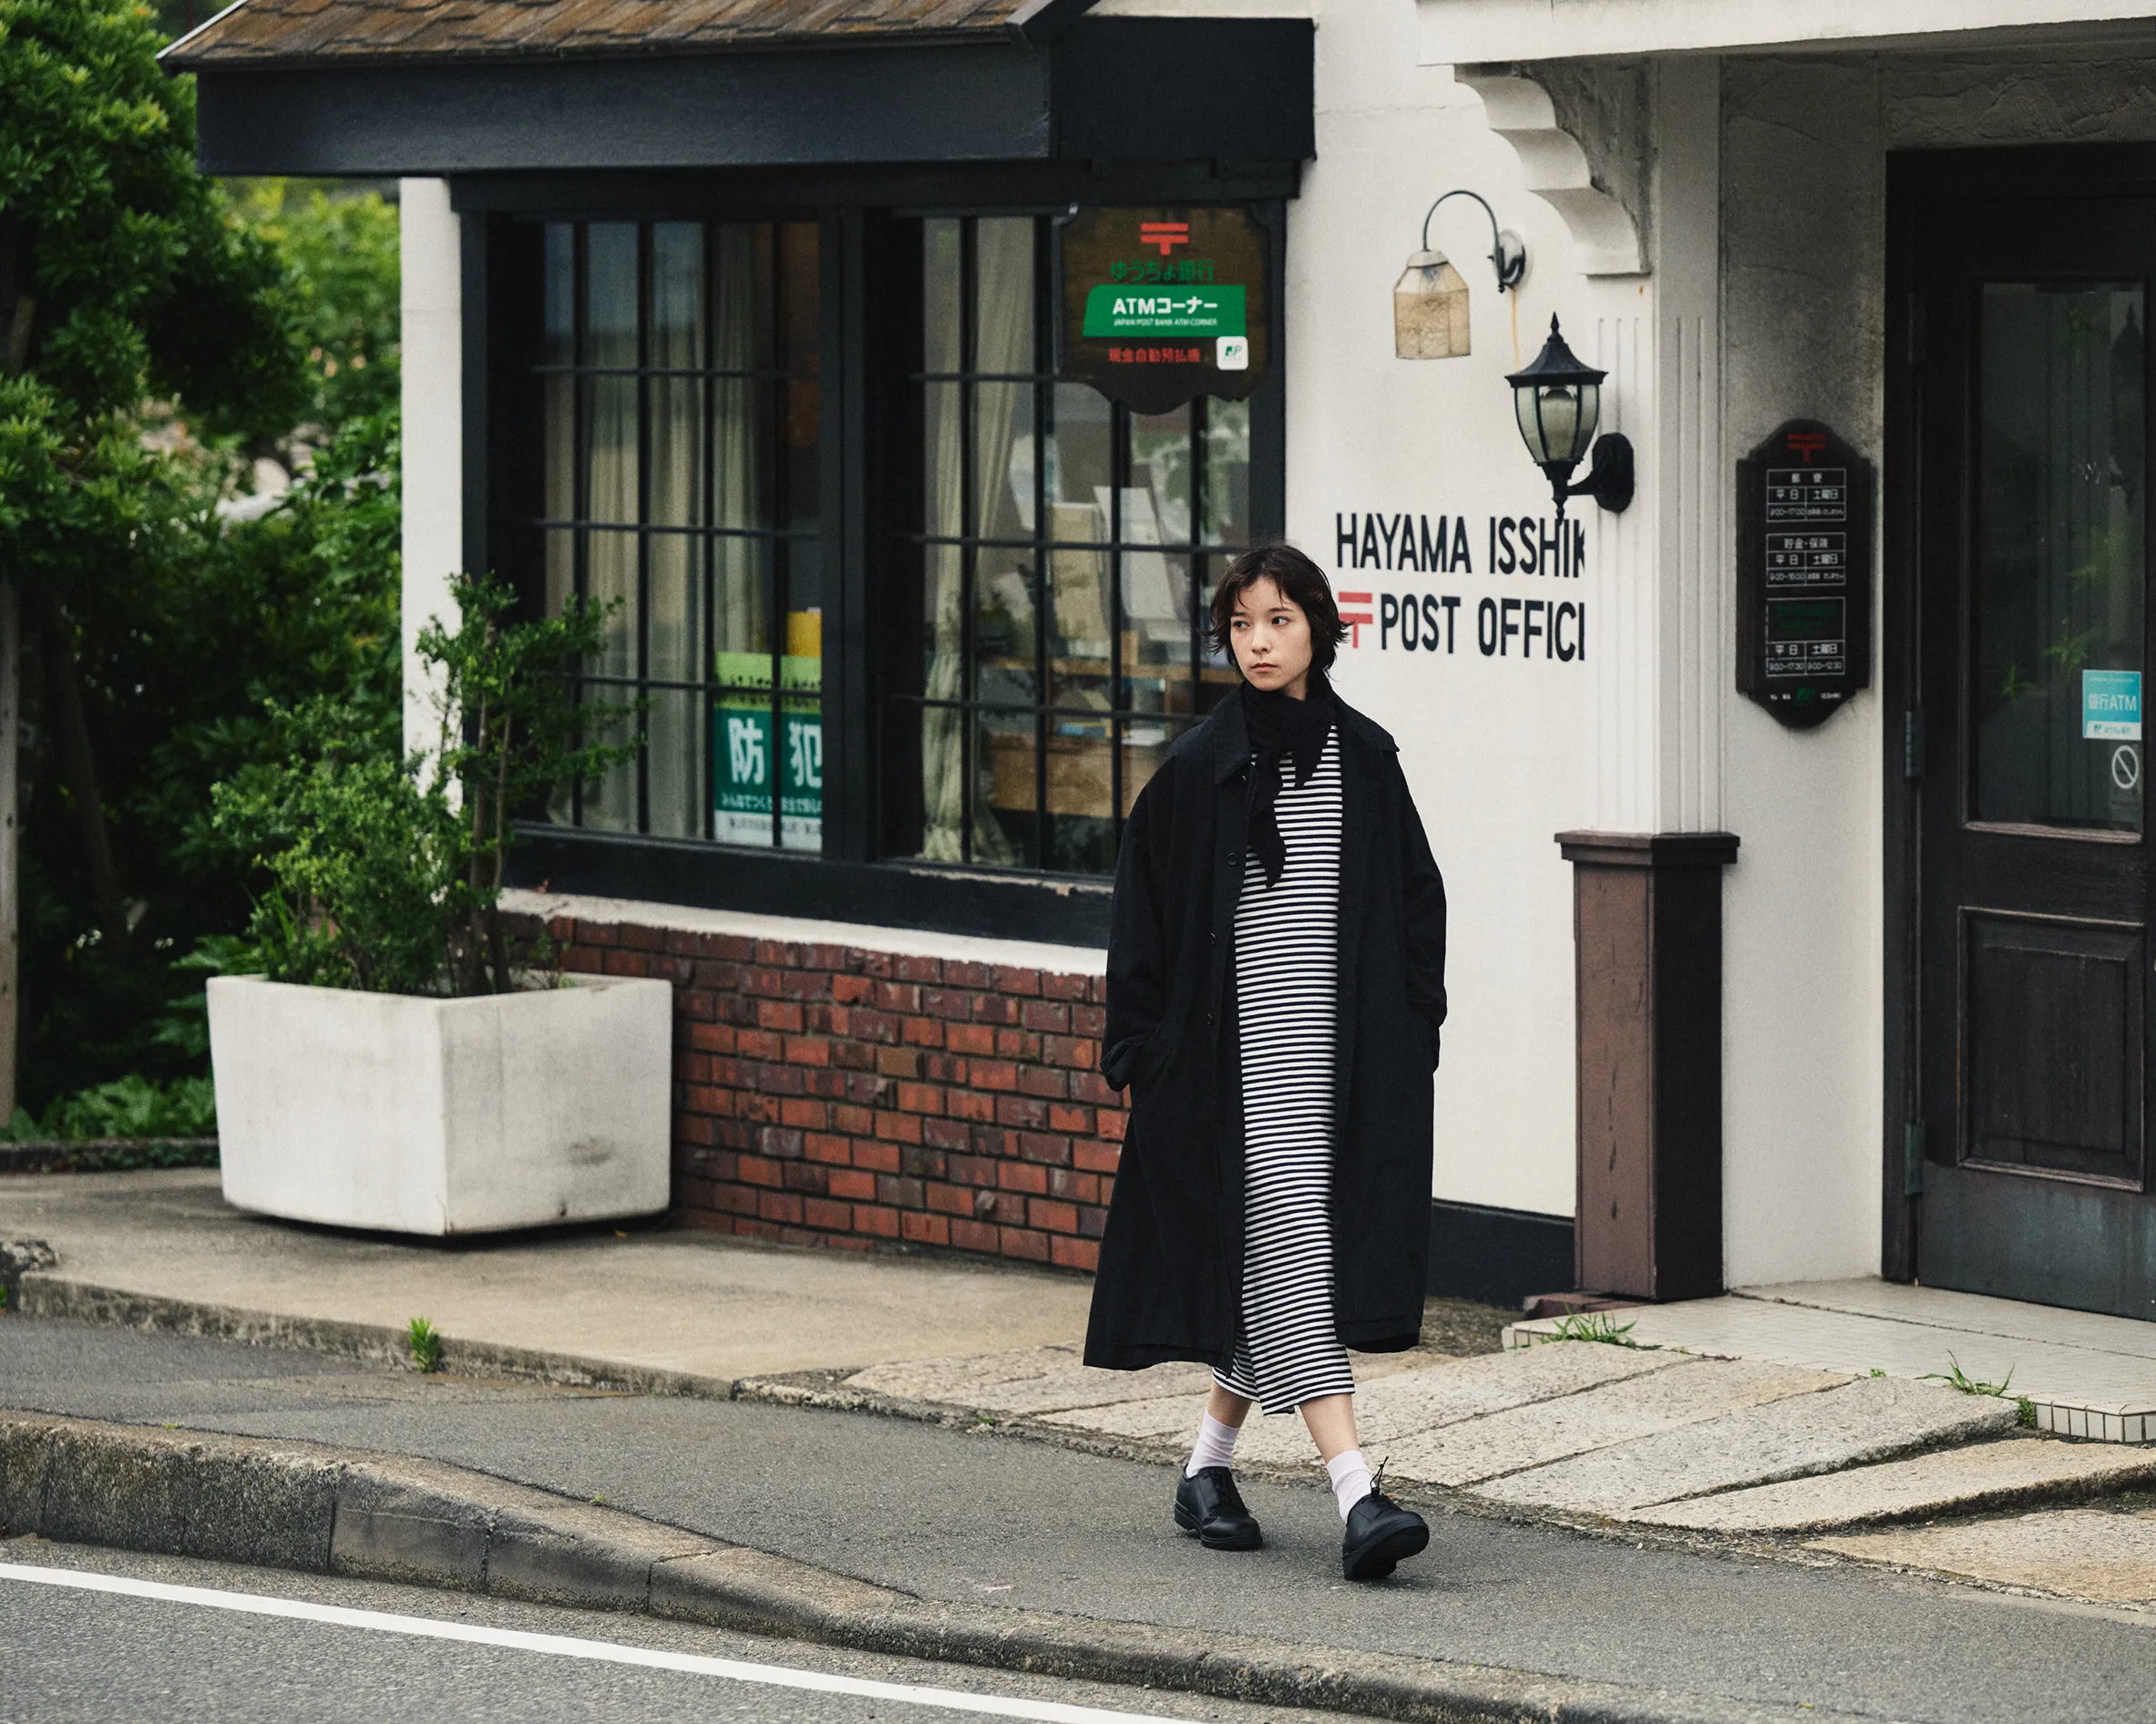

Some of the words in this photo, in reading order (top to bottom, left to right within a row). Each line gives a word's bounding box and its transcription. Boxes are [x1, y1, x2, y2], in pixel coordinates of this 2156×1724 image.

[1110, 260, 1215, 282] ゆうちょ銀行
[1113, 296, 1218, 314] ATMコーナー
[1337, 513, 1473, 574] HAYAMA
[1381, 593, 1461, 654] POST
[728, 717, 822, 788] 防犯
